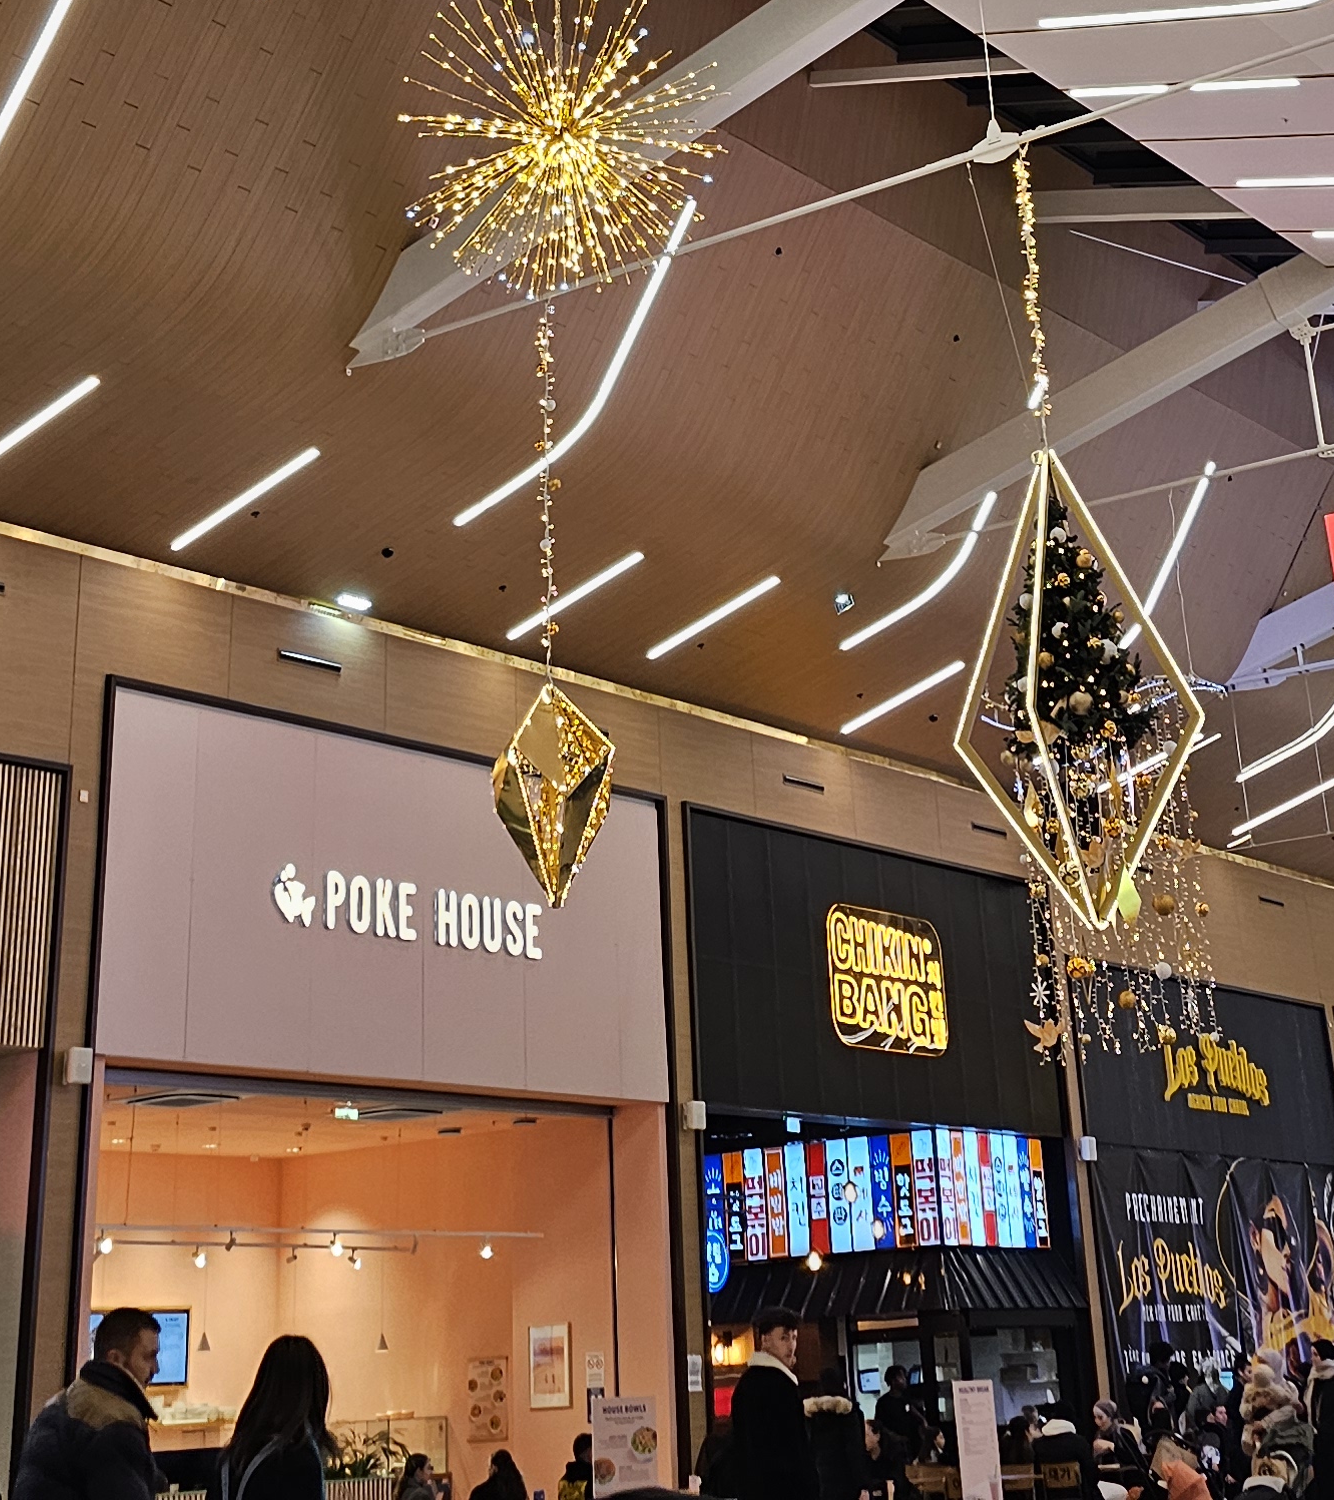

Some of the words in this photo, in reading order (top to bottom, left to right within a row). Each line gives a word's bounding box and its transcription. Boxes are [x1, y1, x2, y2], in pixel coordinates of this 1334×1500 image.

[324, 869, 418, 942] POKE
[433, 887, 543, 960] HOUSE
[834, 973, 931, 1047] BANG
[1163, 1043, 1199, 1102] Los
[1198, 1032, 1271, 1107] Pueblos
[1117, 1239, 1152, 1317] Los
[1153, 1236, 1227, 1310] Pueblos
